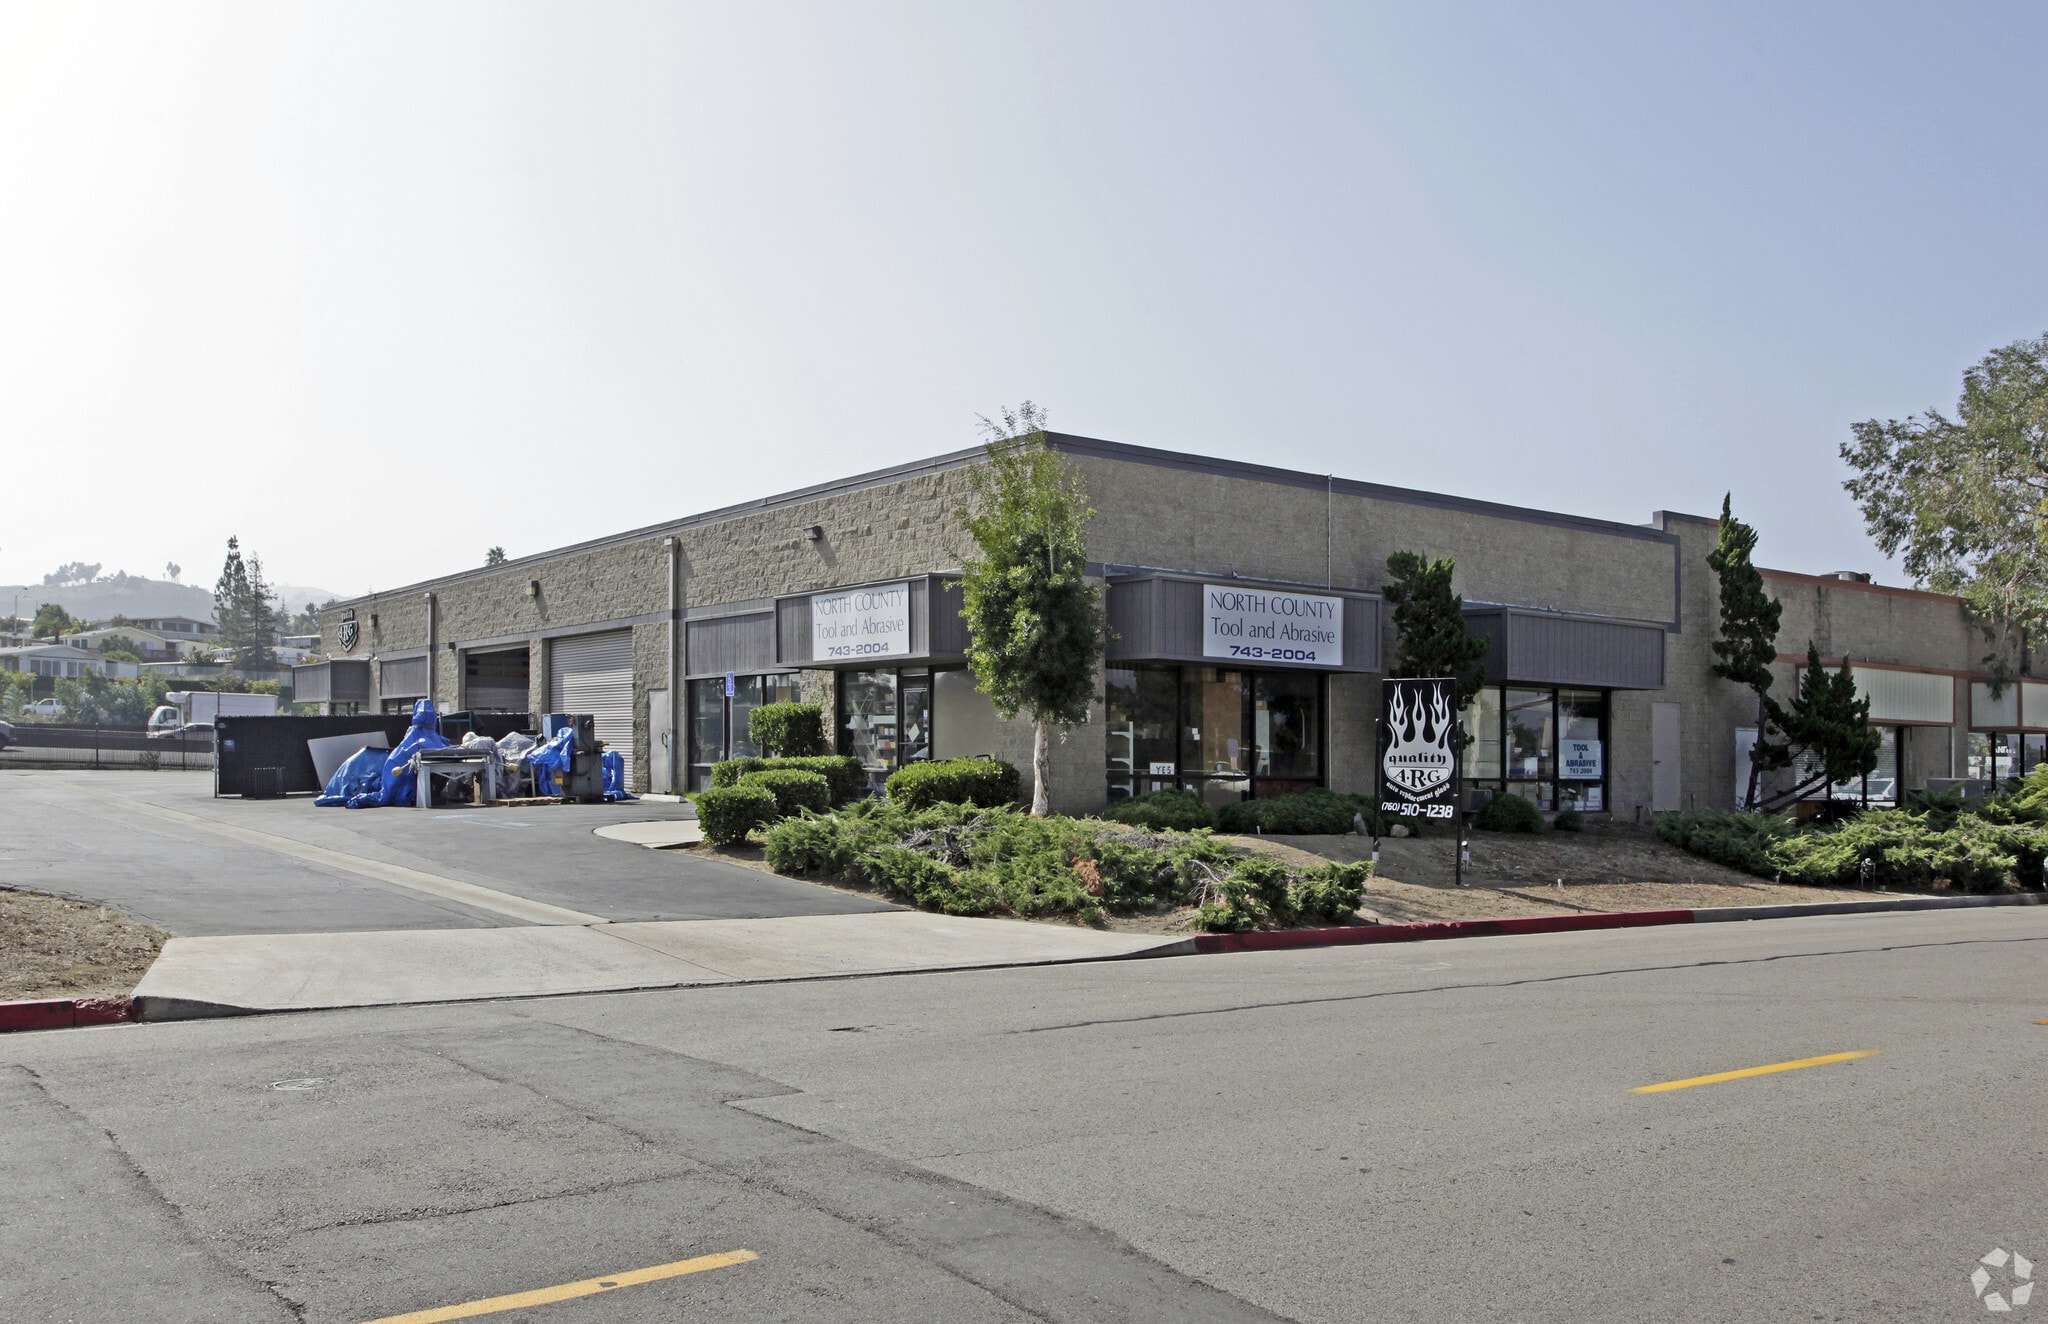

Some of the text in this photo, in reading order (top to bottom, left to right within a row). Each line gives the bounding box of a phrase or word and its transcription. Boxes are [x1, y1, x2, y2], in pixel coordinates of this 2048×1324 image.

[815, 589, 904, 617] NORTH COUNTY
[1210, 592, 1335, 619] NORTH COUNTY
[816, 616, 904, 639] Tool and Abrasive
[1211, 617, 1335, 643] Tool and Abrasive
[828, 642, 889, 657] 743-2004
[1229, 645, 1316, 662] 743-2004
[1389, 752, 1446, 766] quality
[1155, 766, 1171, 774] YES
[1381, 802, 1454, 818] (760) 510-1238
